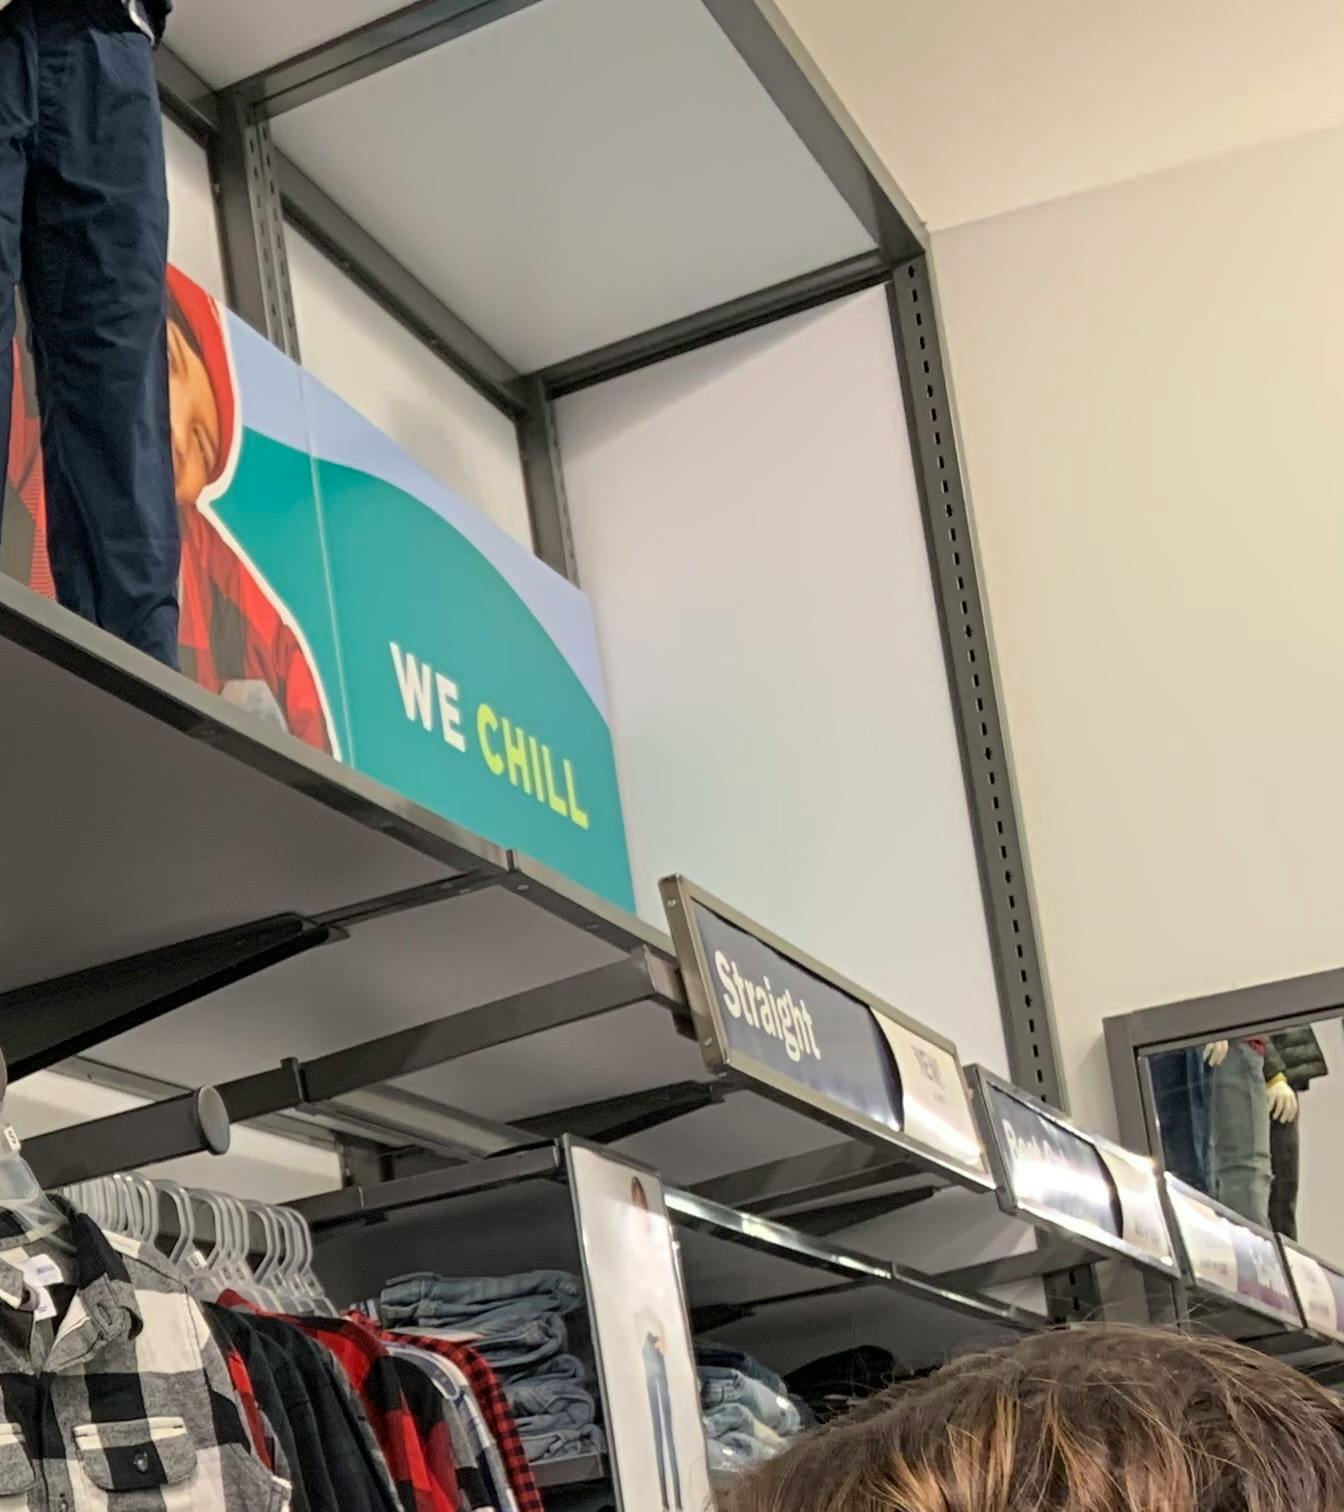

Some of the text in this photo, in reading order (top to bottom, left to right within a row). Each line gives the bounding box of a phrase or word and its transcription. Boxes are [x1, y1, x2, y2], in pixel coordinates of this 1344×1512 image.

[389, 641, 589, 830] WE CHILL
[715, 950, 821, 1062] Straight
